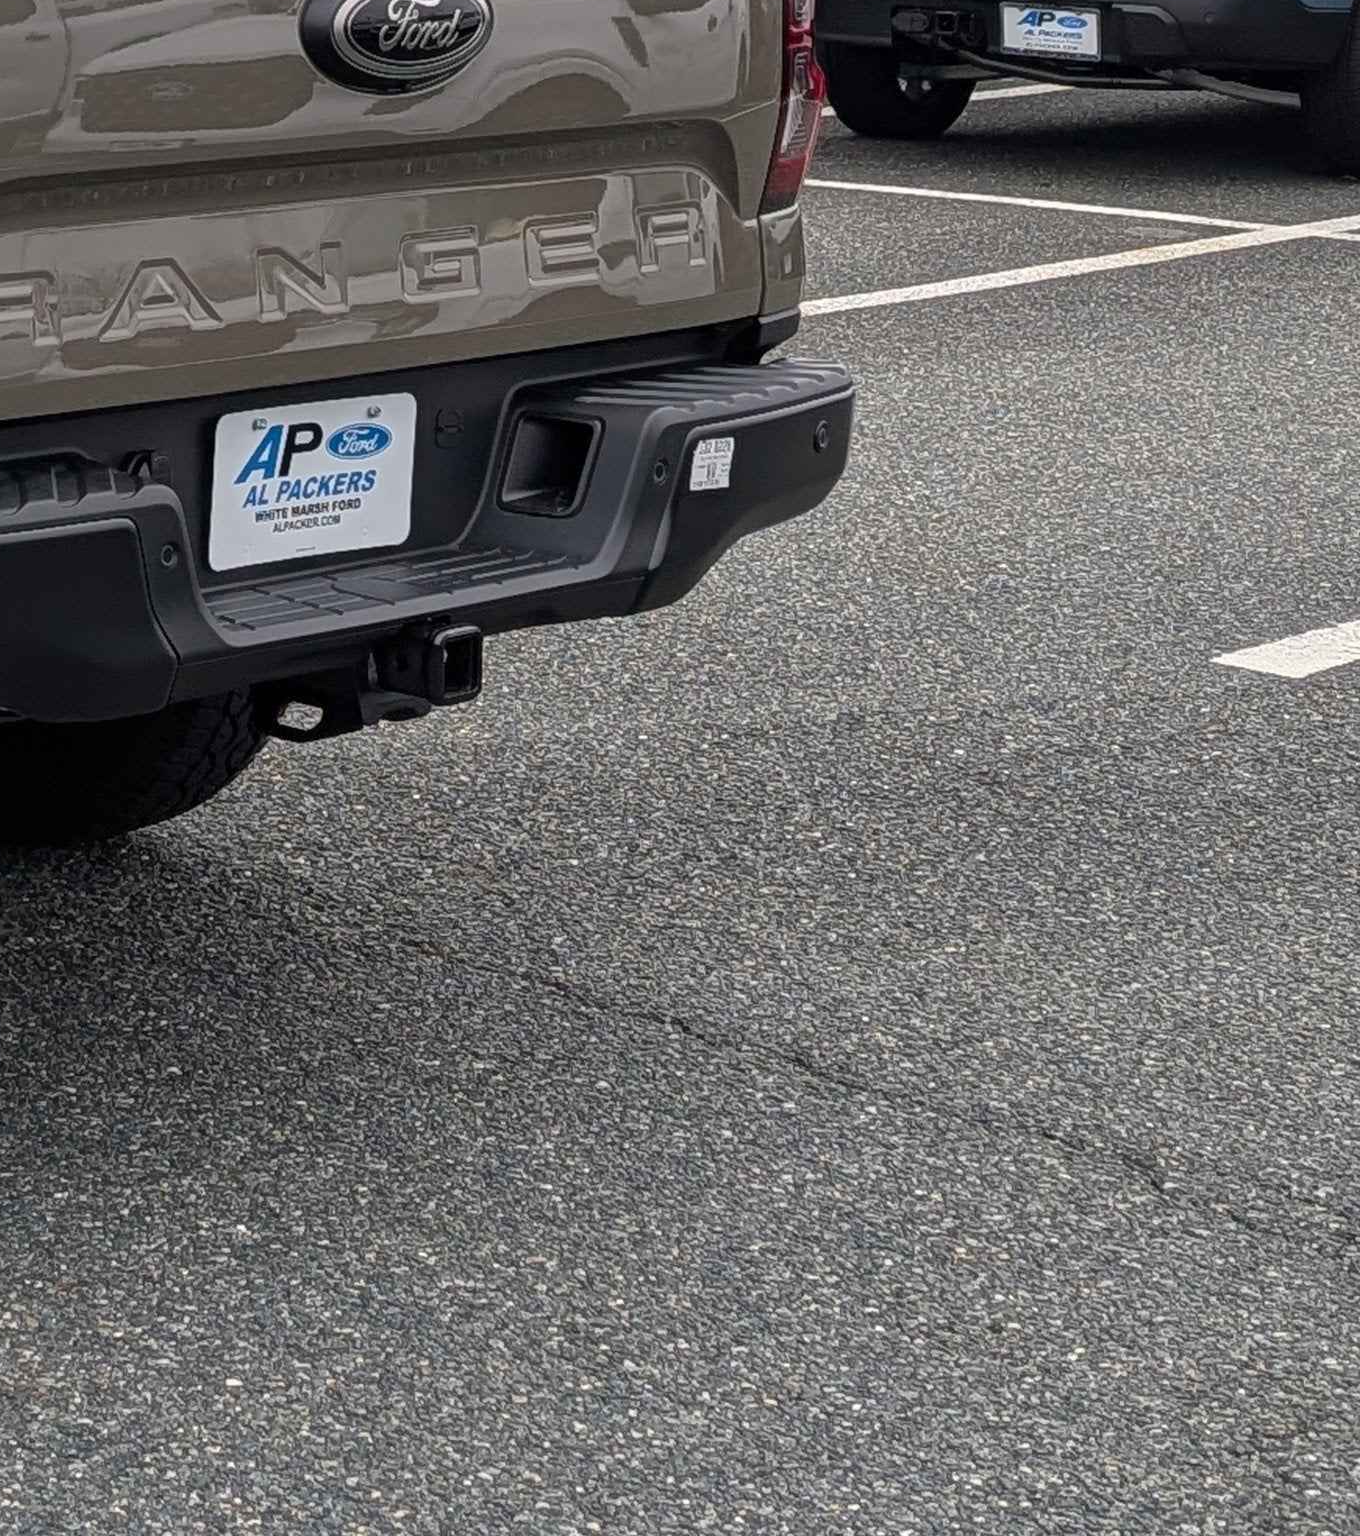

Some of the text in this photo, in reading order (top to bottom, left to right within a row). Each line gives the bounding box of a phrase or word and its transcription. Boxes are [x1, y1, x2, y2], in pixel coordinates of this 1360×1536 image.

[1016, 10, 1056, 27] AP
[234, 421, 324, 485] AP
[337, 427, 380, 455] Ford
[242, 469, 378, 509] AL PACKERS
[255, 497, 362, 523] WHITE MARSH FORD
[272, 514, 342, 534] ALPACKER.COM
